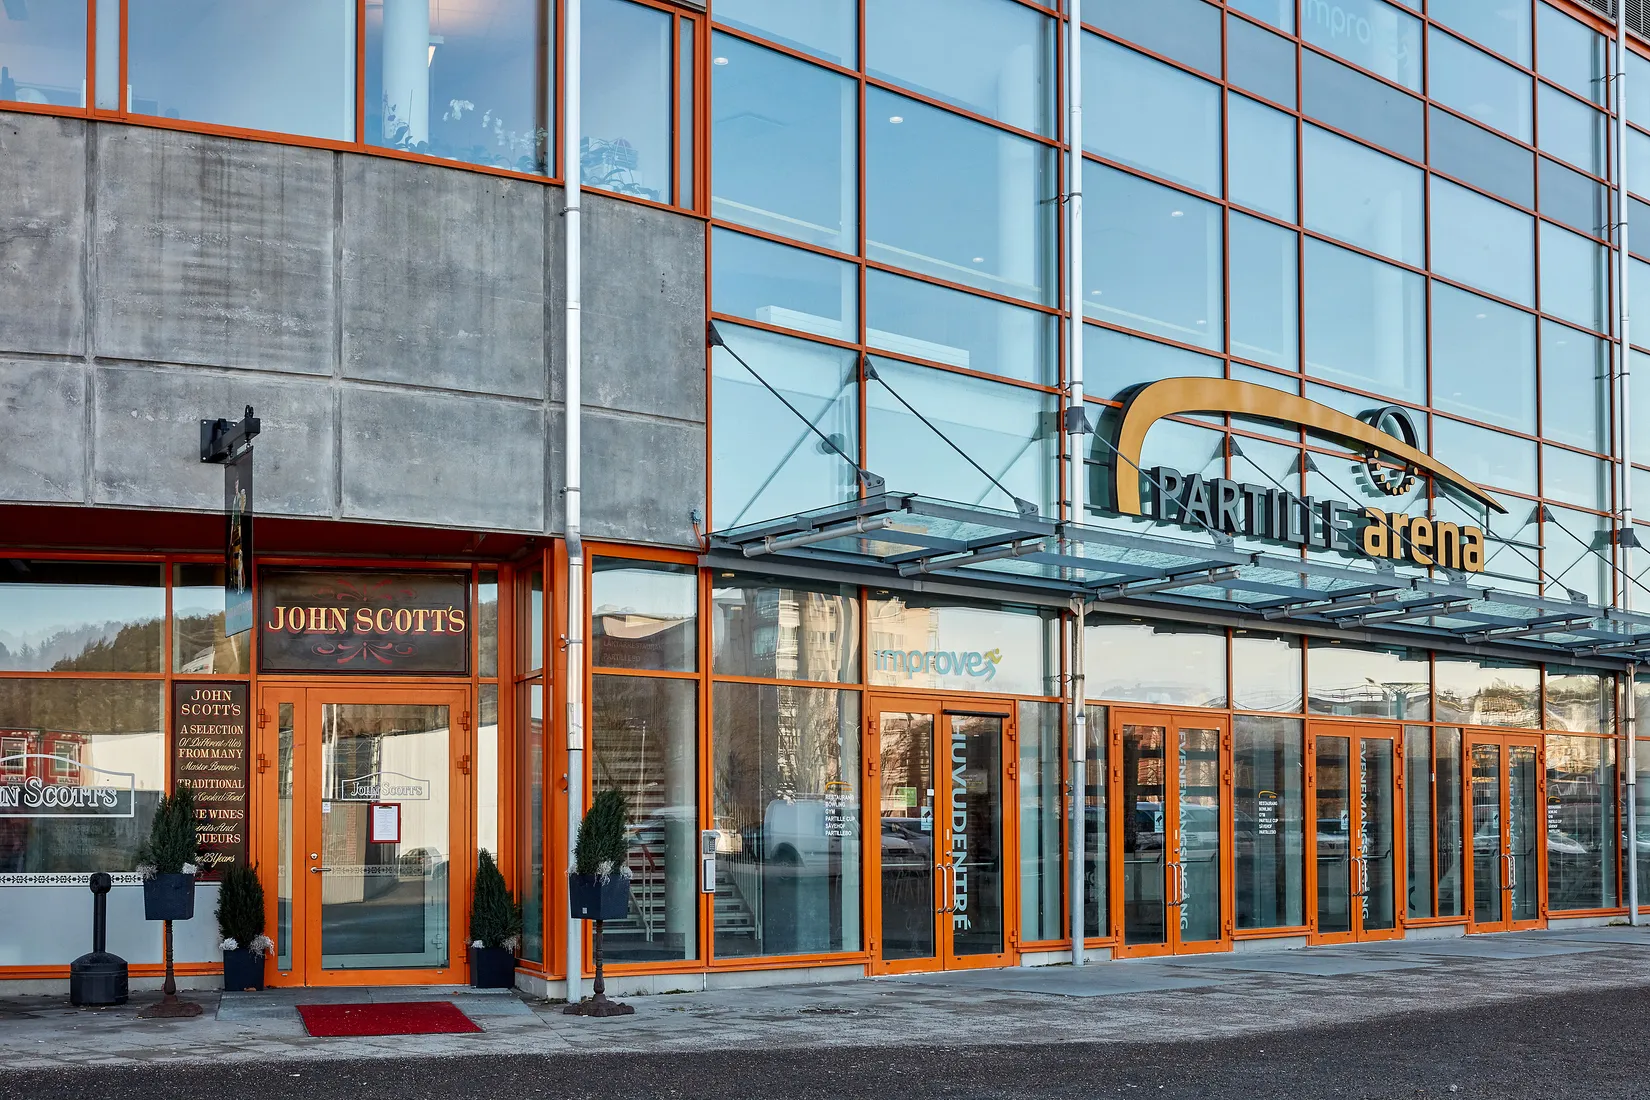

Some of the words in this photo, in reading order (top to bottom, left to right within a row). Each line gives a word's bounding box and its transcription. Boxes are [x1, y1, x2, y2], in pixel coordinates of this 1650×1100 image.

[1151, 466, 1353, 551] PARTILLE
[1358, 506, 1485, 573] arena
[267, 606, 350, 633] JOHN
[354, 605, 466, 634] SCOTT'S
[874, 649, 991, 681] improve
[190, 689, 232, 701] JOHN
[181, 703, 241, 716] SCOTT'S
[180, 724, 188, 734] A
[190, 724, 244, 735] SELECTION
[178, 737, 190, 747] Of
[189, 737, 223, 747] Different
[178, 748, 209, 758] FROM
[211, 748, 244, 759] MANY
[180, 761, 208, 771] Master
[177, 778, 245, 789] TRADITIONAL
[225, 791, 246, 801] Food
[208, 809, 244, 819] WINES
[951, 719, 972, 931] HUVUDENTRÉ
[195, 833, 241, 844] QUEURS
